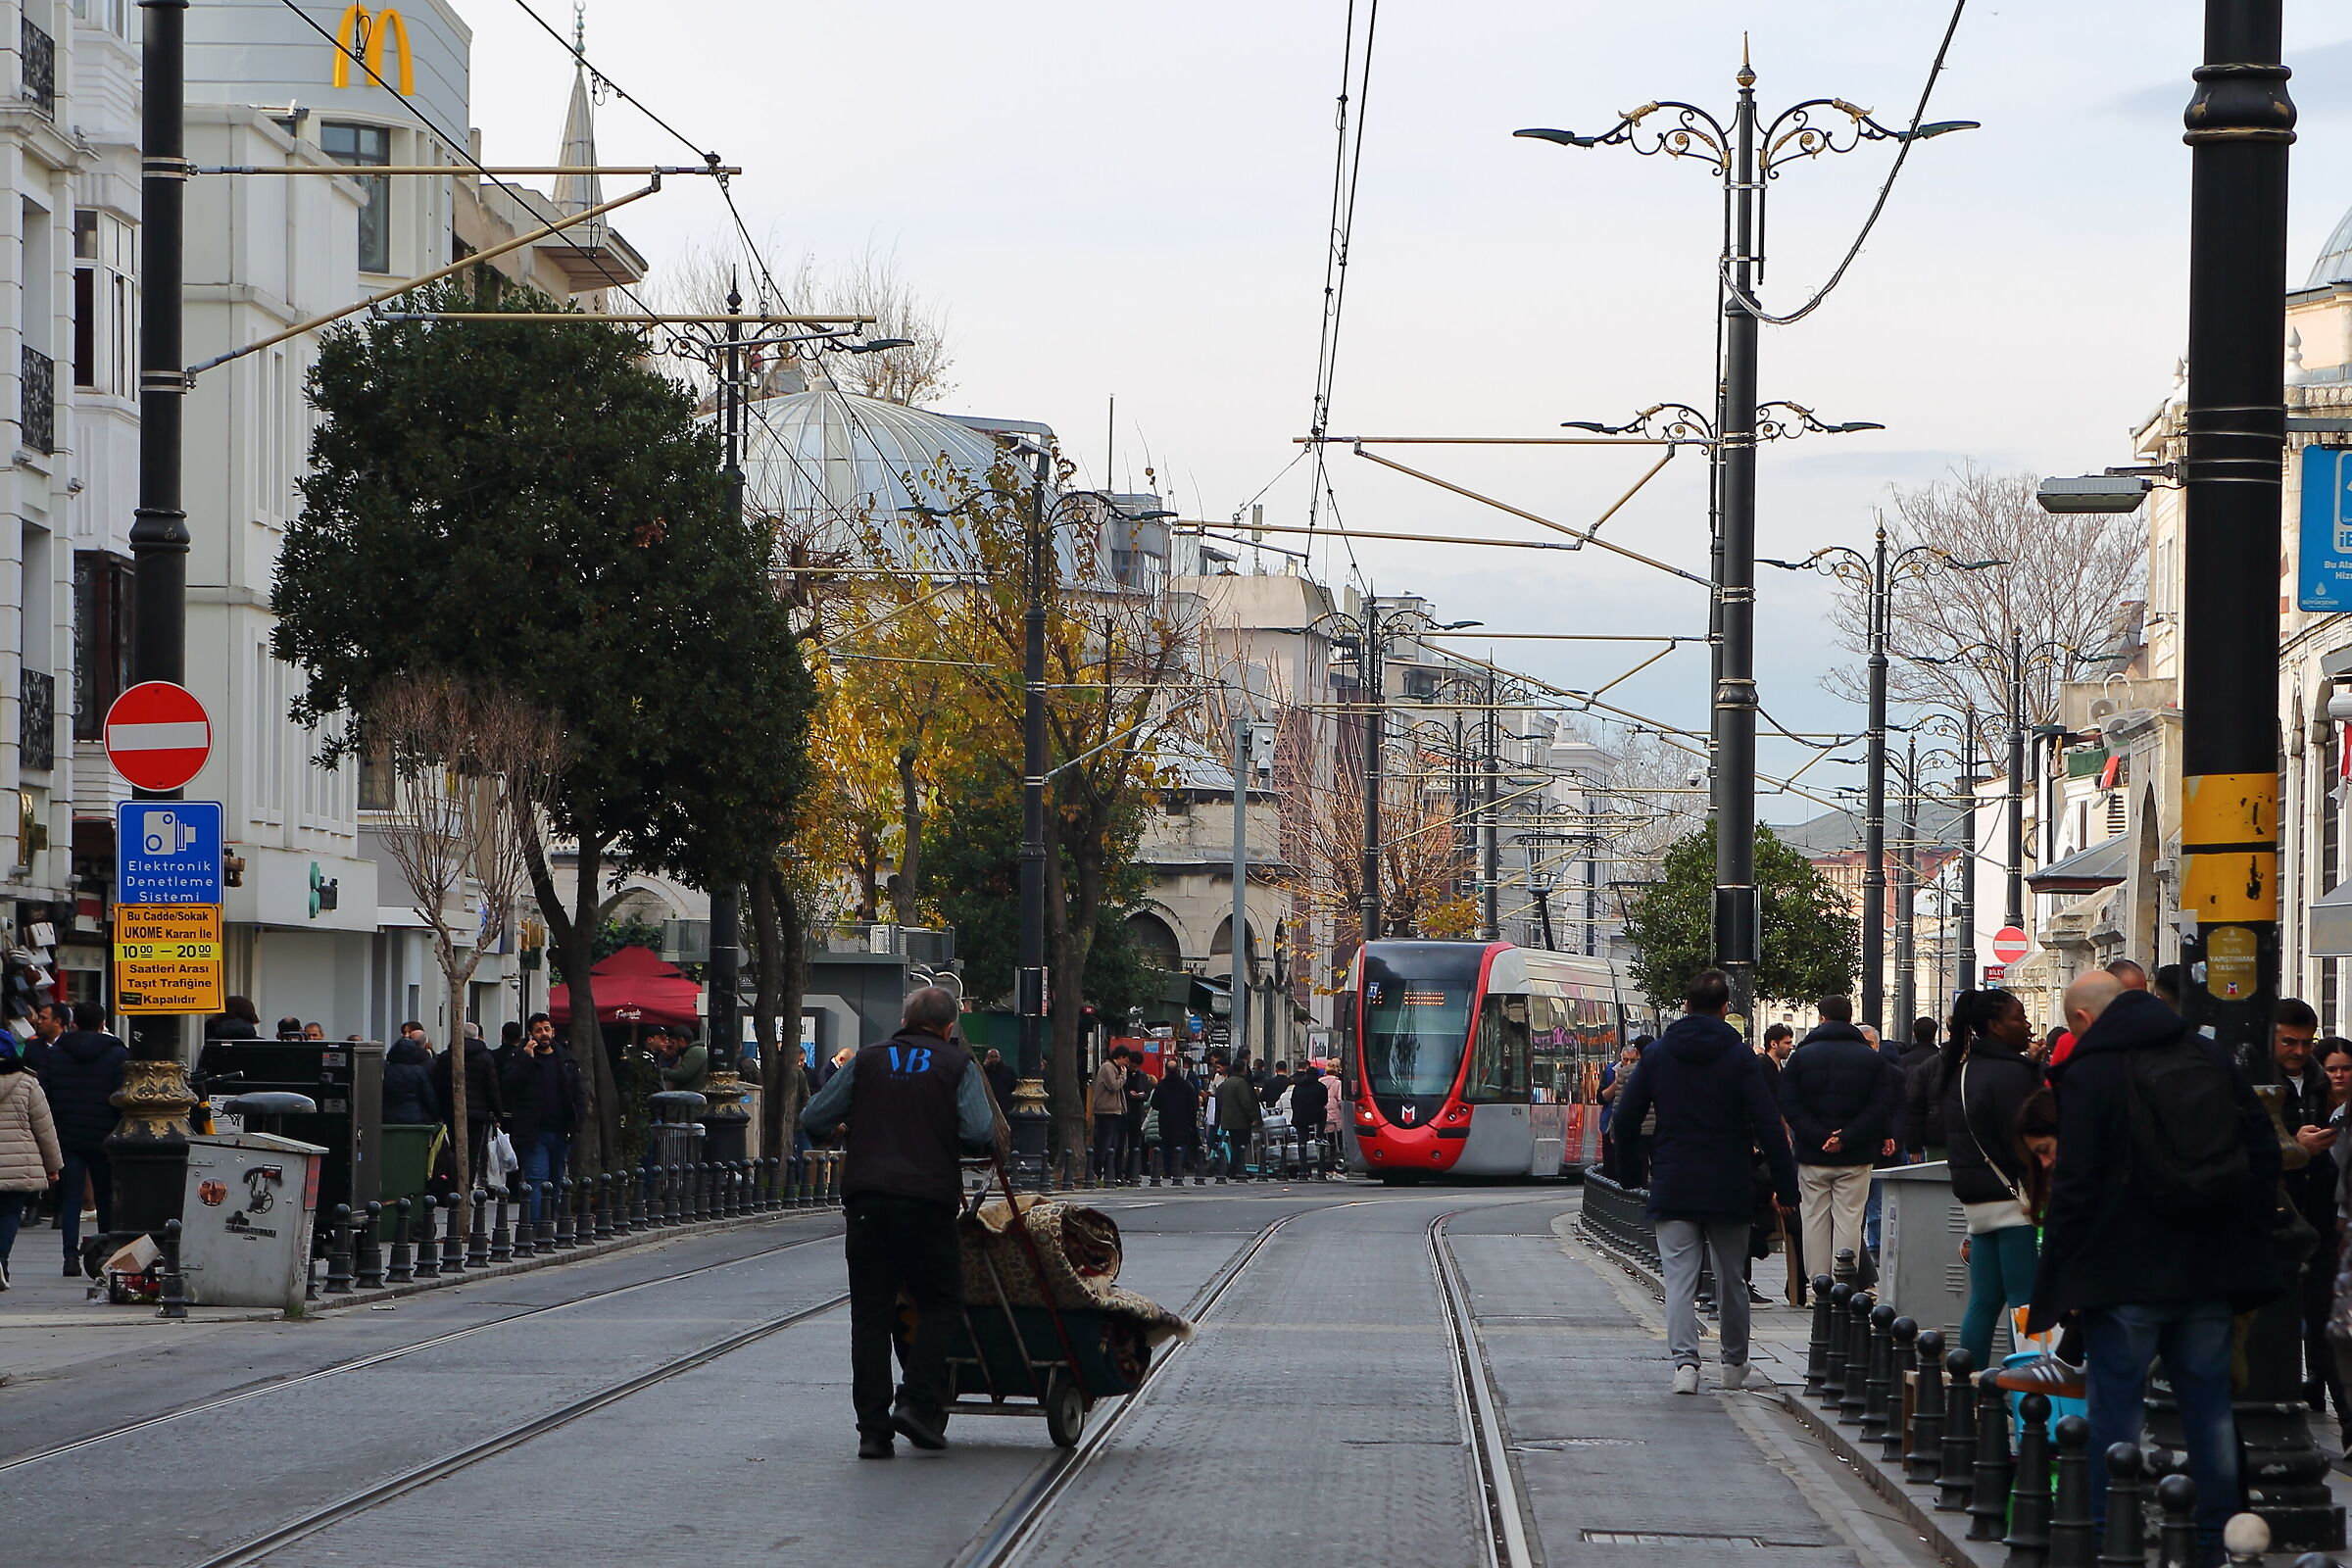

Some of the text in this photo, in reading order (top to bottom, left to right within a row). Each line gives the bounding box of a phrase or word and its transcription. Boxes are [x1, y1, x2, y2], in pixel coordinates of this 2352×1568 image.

[128, 860, 211, 871] Elektronik
[126, 876, 214, 886] Denetleme
[139, 891, 200, 902] Sistemi
[127, 911, 209, 921] Bu Cadde/Sokak
[124, 926, 163, 939] UKOME
[199, 926, 212, 939] İle
[129, 964, 209, 973] Saatleri Arası
[126, 978, 212, 990] Taşıt Trafiğine
[143, 995, 196, 1005] Kapalıdır
[888, 1046, 932, 1073] VB
